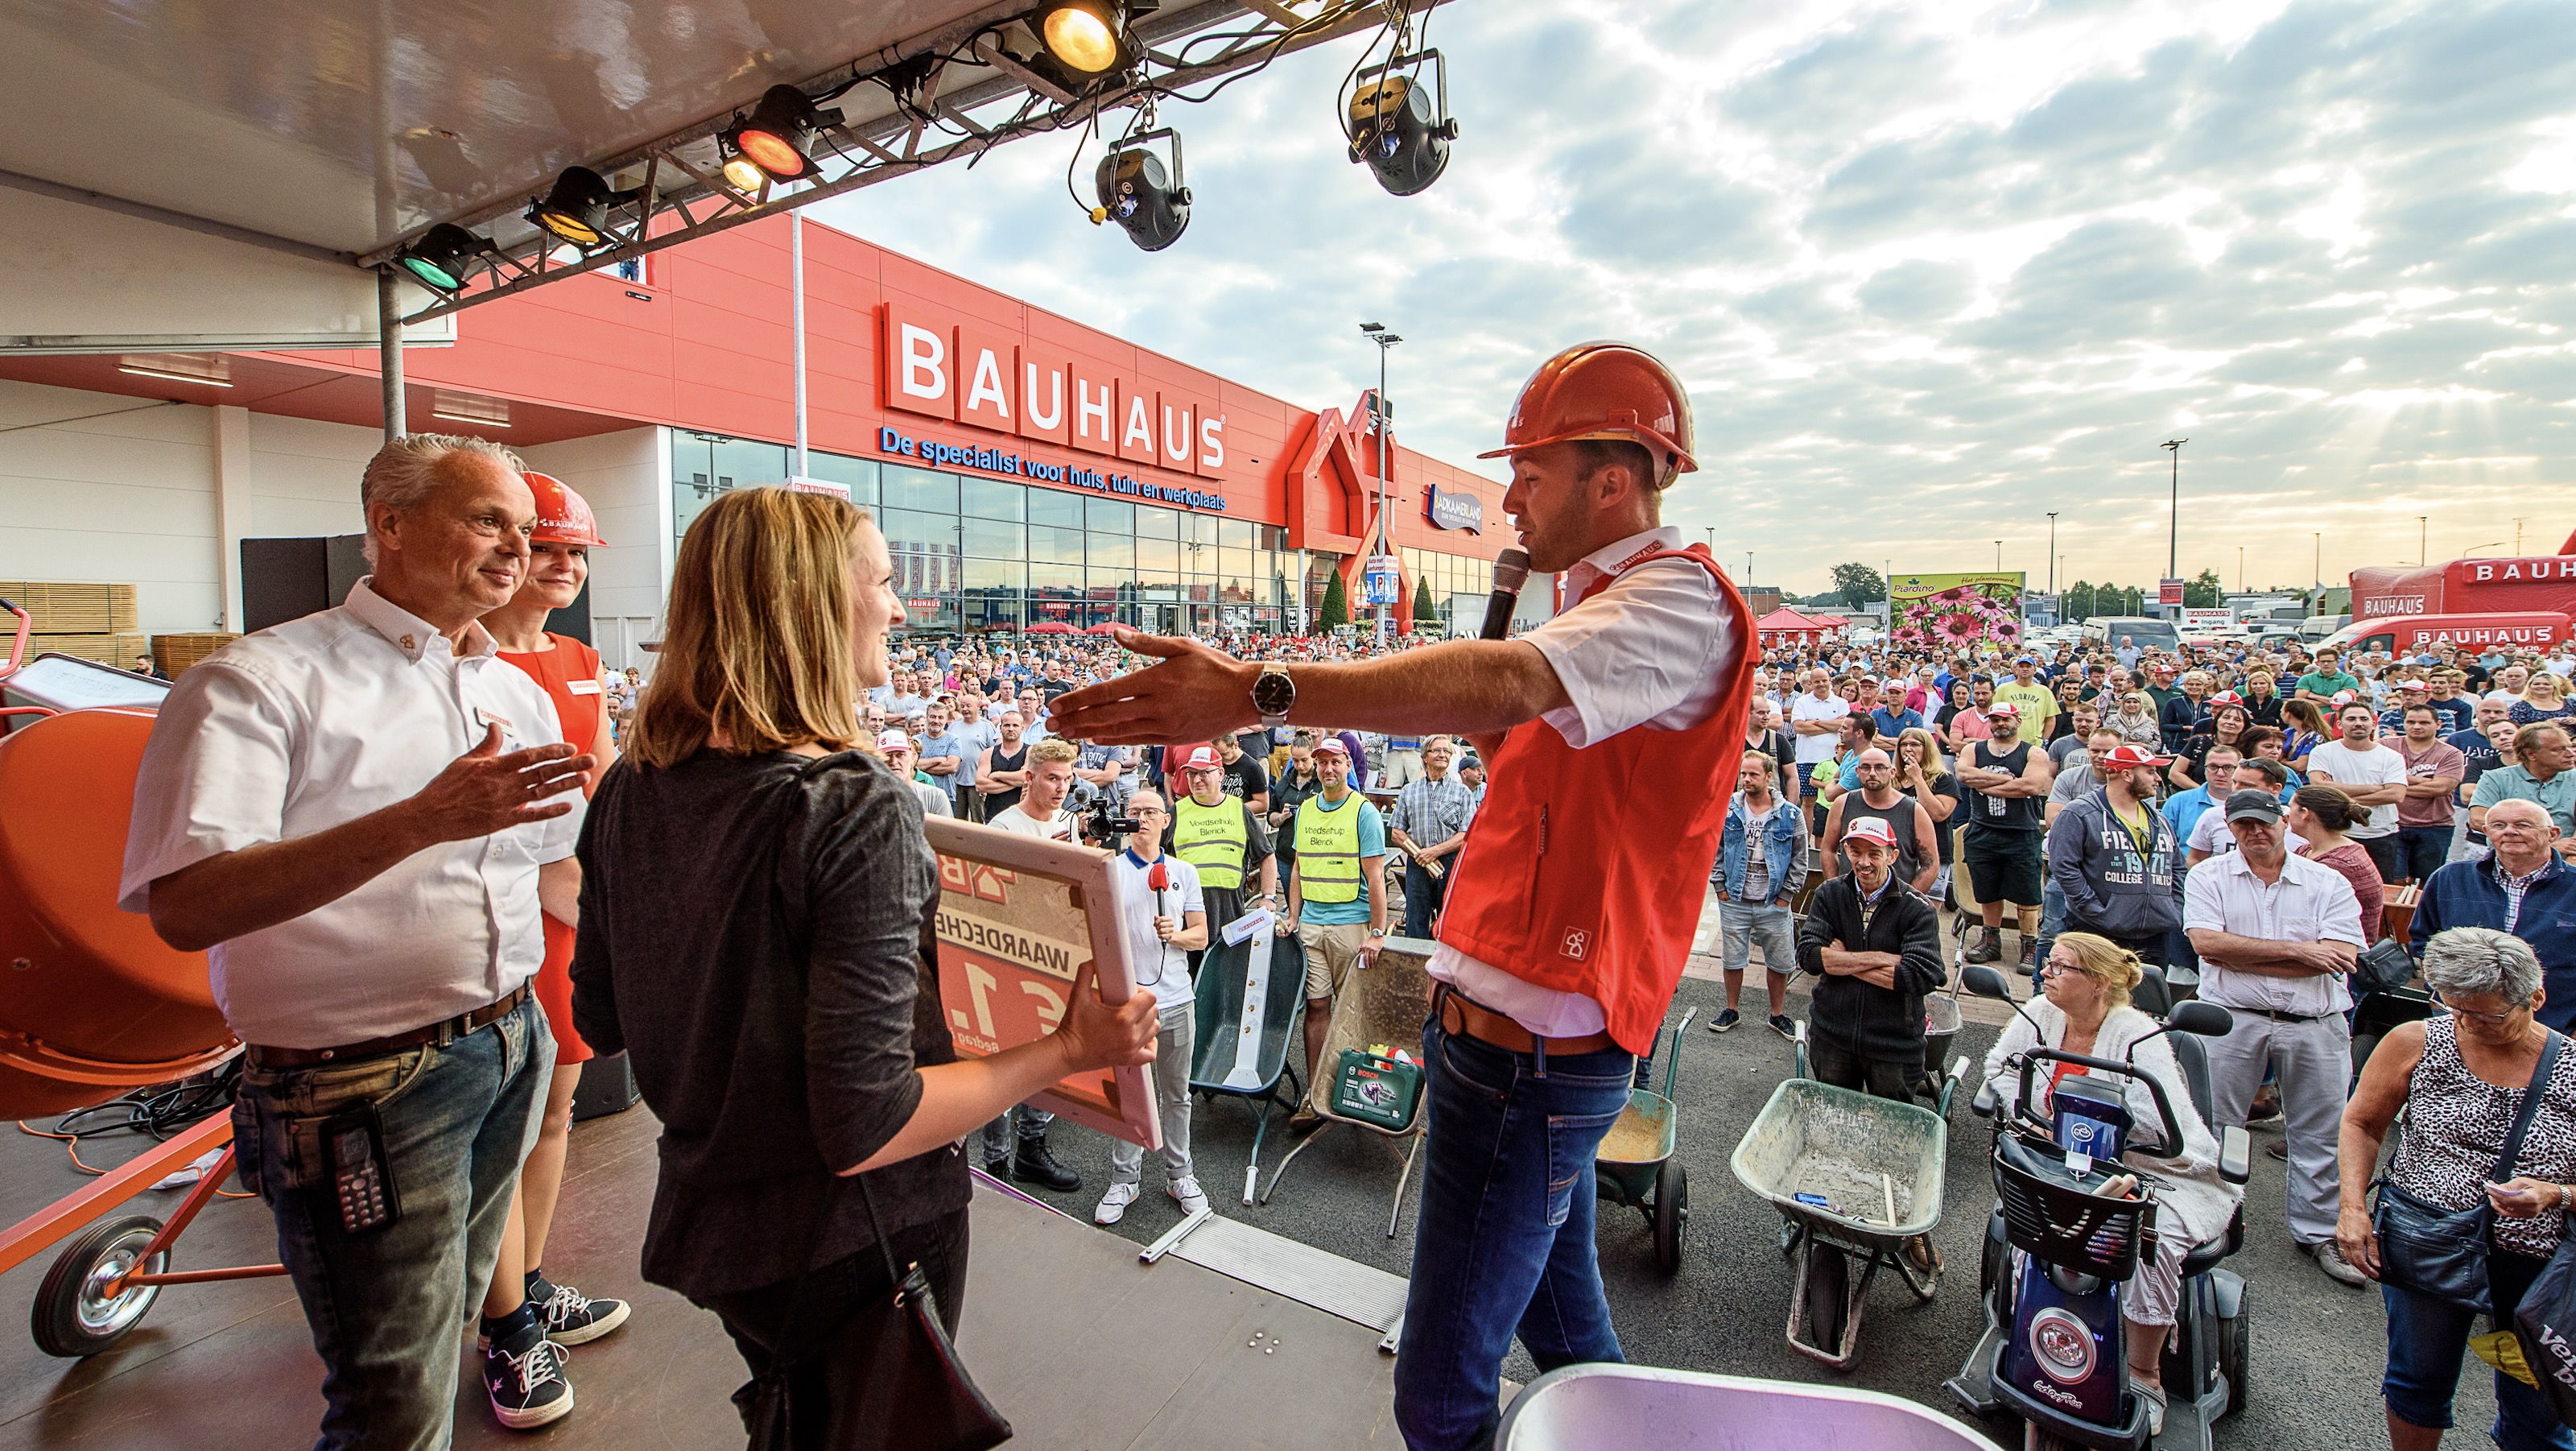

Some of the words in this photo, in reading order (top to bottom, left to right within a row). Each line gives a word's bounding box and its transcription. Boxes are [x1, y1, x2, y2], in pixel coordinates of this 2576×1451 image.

[901, 322, 1225, 468] BAUHAUS
[881, 427, 914, 455] De
[920, 440, 1022, 475] specialist
[1025, 460, 1066, 482] voor
[1069, 465, 1108, 493] huis,
[1111, 473, 1139, 495] tuin
[1141, 483, 1160, 499] en
[1162, 486, 1226, 511] werkplaats
[1435, 494, 1482, 521] BADKAMERLAND
[548, 521, 587, 531] BAUHAUS
[1377, 577, 1383, 589] P
[1393, 577, 1397, 590] P
[1975, 576, 2015, 584] plantenmerk
[1893, 585, 1934, 593] Piardino
[2365, 597, 2424, 614] BAUHAUS
[912, 608, 936, 618] CAFE
[1049, 610, 1067, 619] CAFE
[2417, 629, 2551, 644] BAUHAUS
[2010, 693, 2040, 704] FLORIDA
[1189, 818, 1235, 827] Voedselhulp
[1199, 828, 1226, 837] Blerick
[1304, 826, 1345, 836] Voedselhulp
[1310, 837, 1334, 846] Blerick
[2124, 852, 2143, 873] 19
[2151, 853, 2165, 874] 71
[2104, 871, 2144, 884] COLLEGE
[1357, 1069, 1379, 1080] BOSCH
